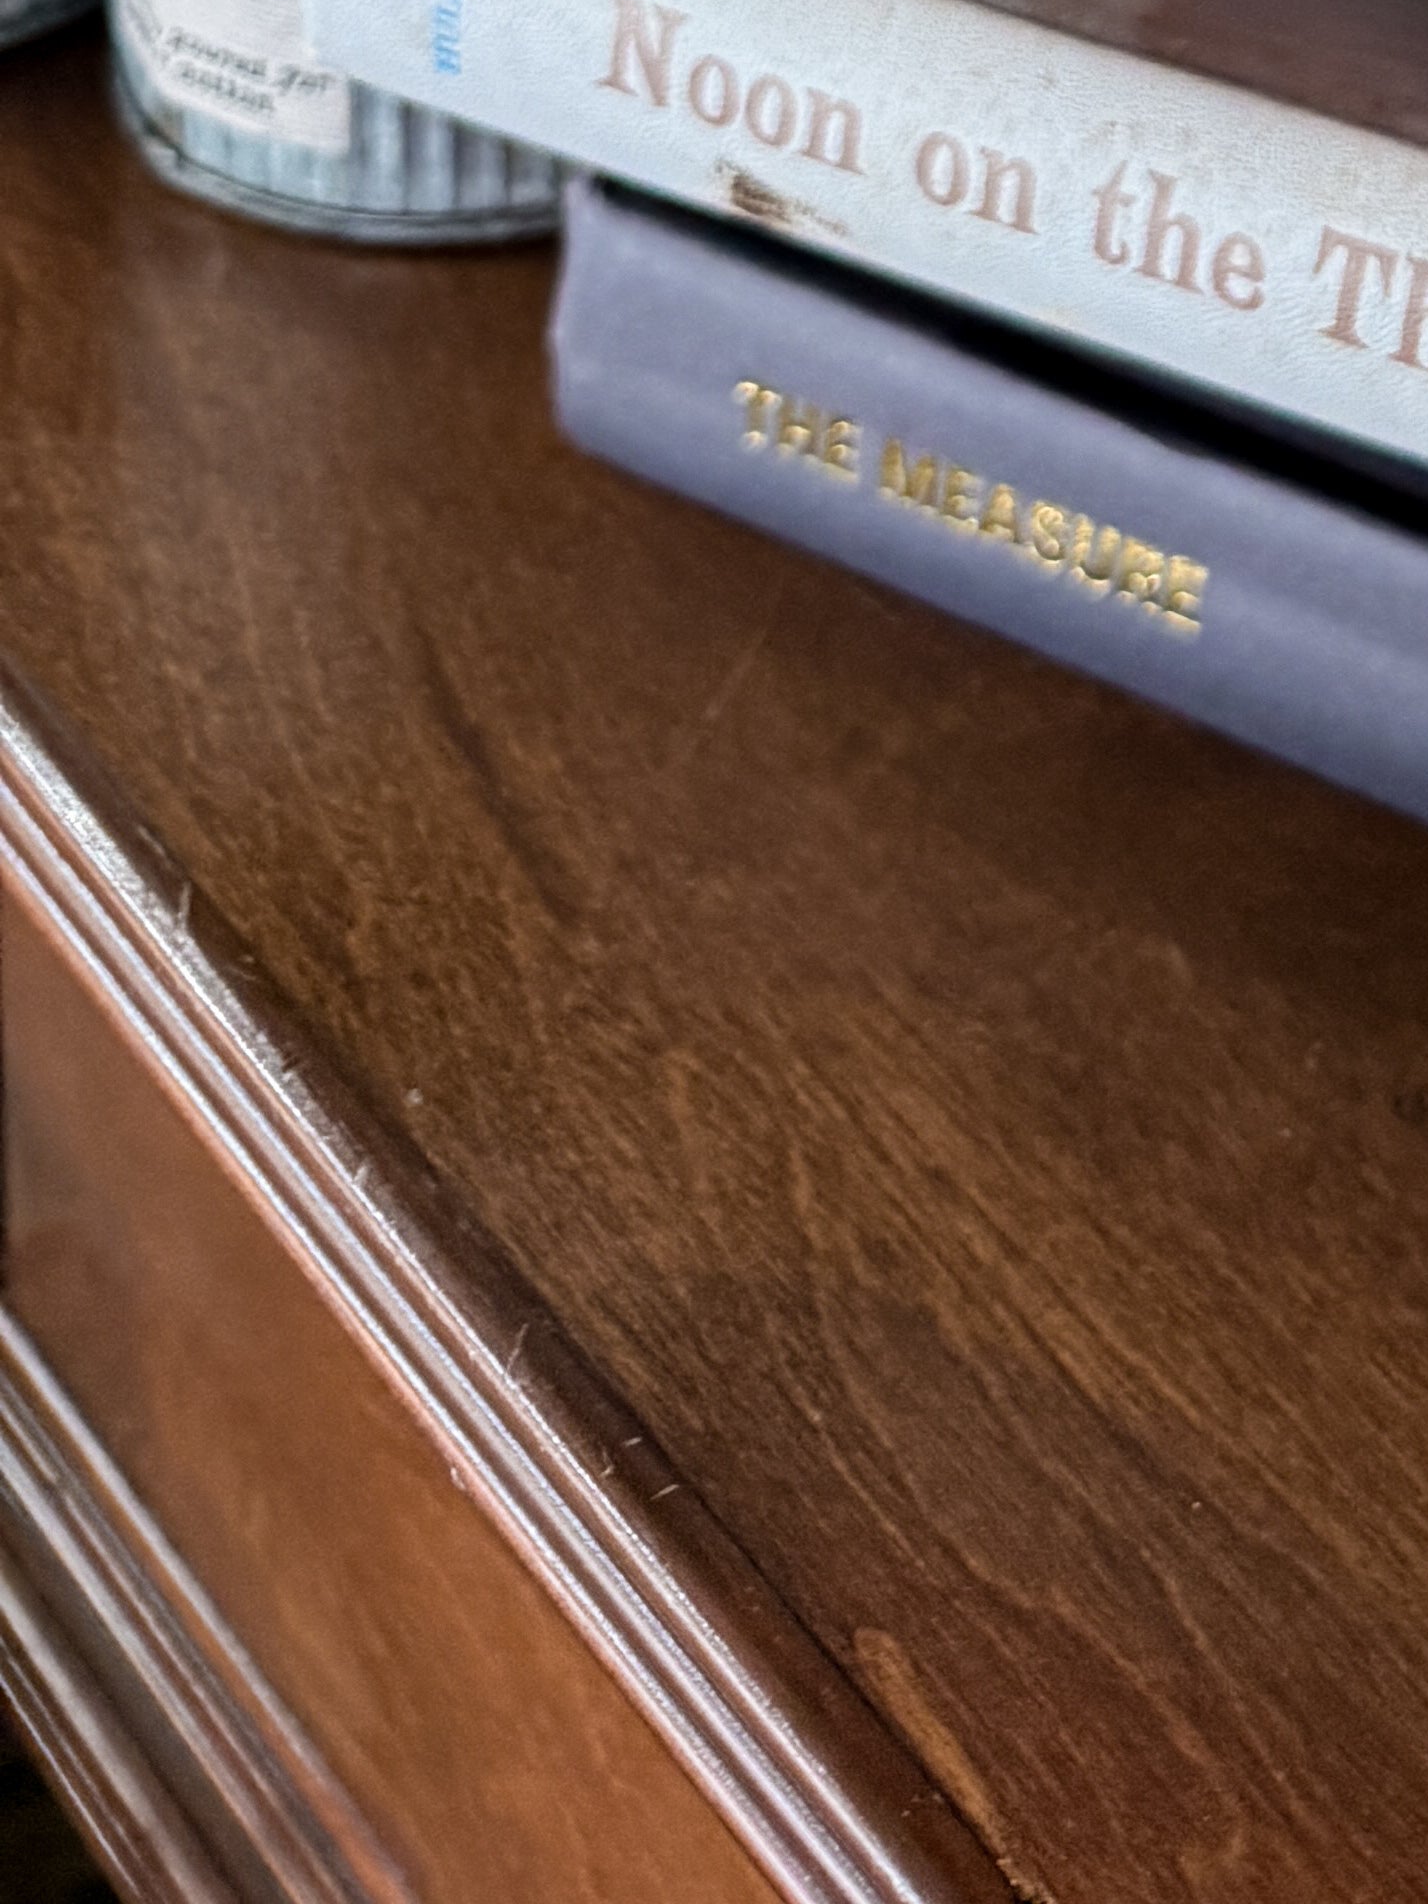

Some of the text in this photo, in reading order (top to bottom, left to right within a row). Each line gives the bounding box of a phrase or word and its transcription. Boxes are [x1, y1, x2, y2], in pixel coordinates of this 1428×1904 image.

[913, 129, 1039, 235] on
[1092, 158, 1265, 311] the
[733, 379, 1211, 635] THE MEASURE
